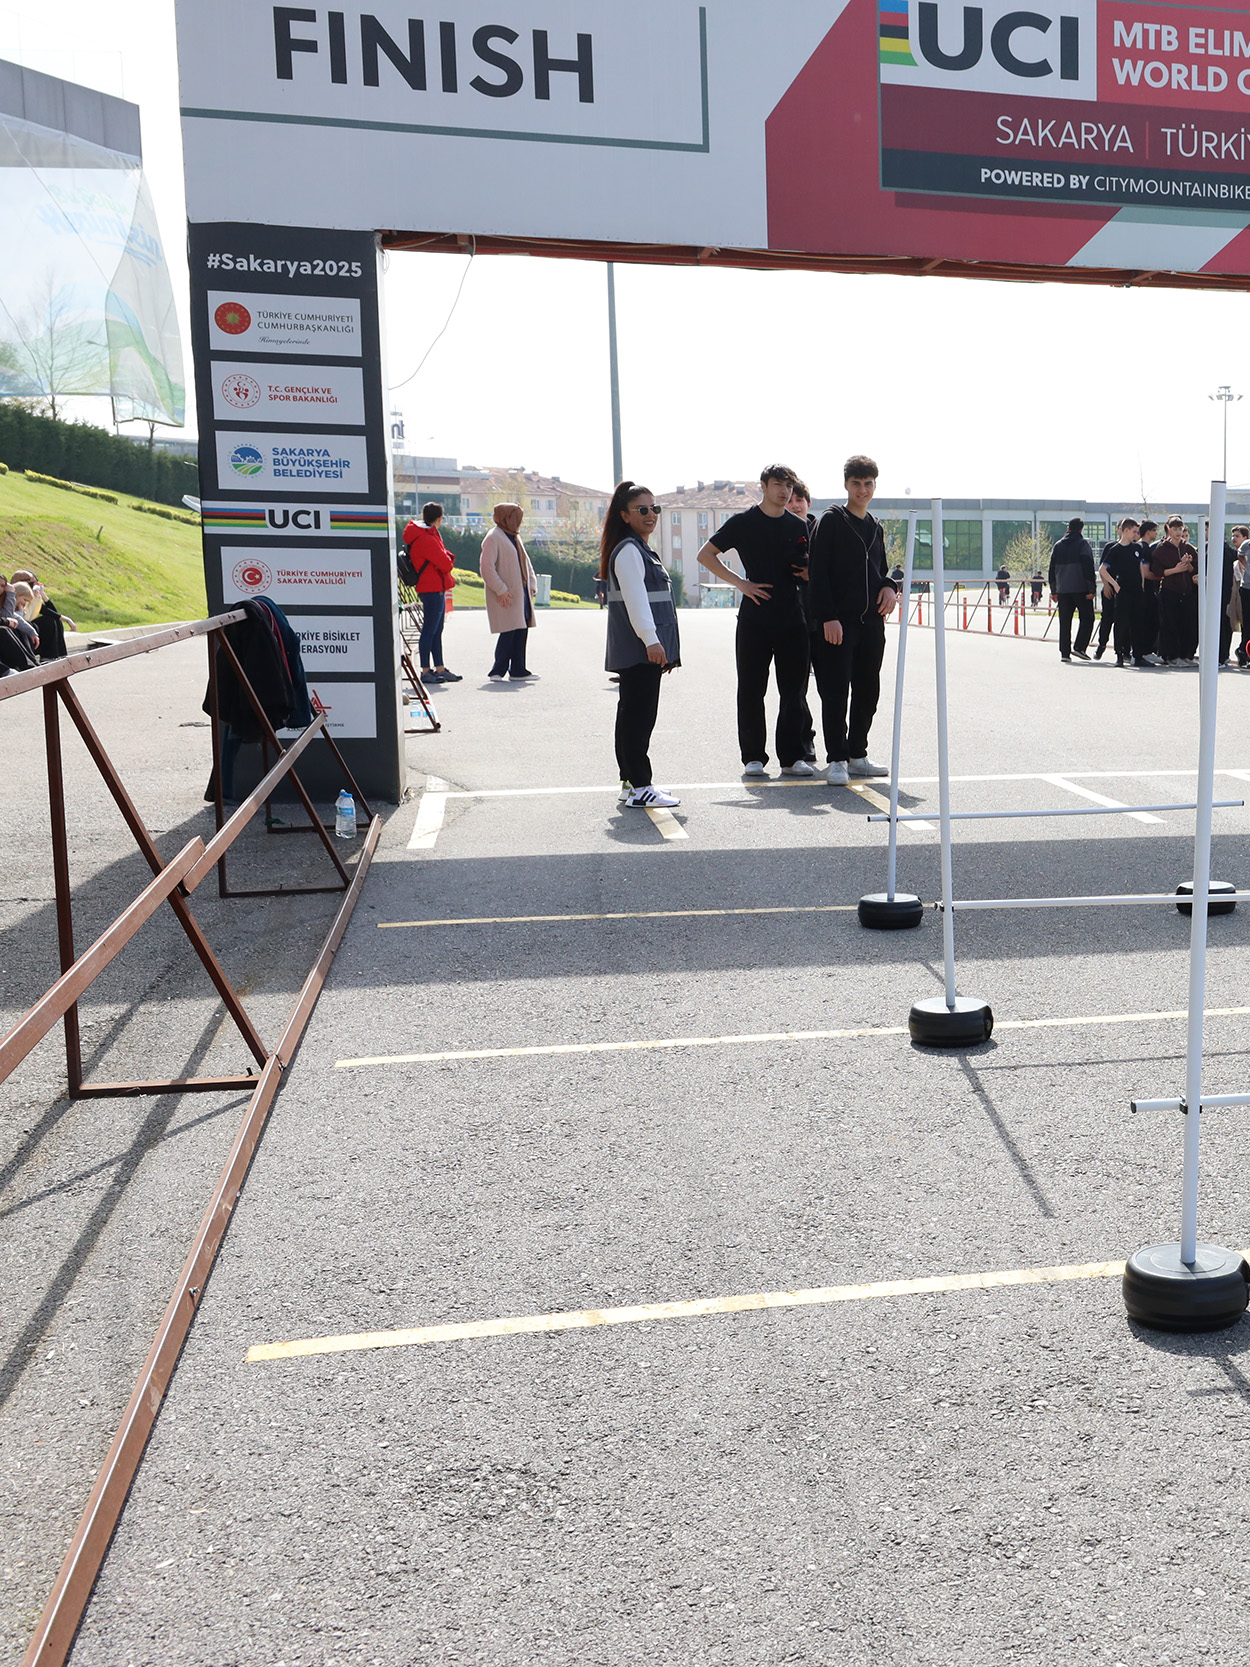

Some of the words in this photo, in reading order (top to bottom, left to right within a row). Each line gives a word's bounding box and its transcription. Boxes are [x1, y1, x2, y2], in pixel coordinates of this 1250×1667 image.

[918, 1, 1079, 81] UCI
[1113, 20, 1179, 52] MTB
[273, 6, 594, 104] FINISH
[1112, 58, 1228, 91] WORLD
[995, 115, 1134, 154] SAKARYA
[980, 168, 1065, 189] POWERED
[1068, 175, 1090, 190] BY
[207, 253, 363, 278] #Sakarya2025
[257, 311, 292, 320] TÜRKİYE
[294, 313, 354, 323] CUMHURİYETİ
[257, 322, 354, 333] CUMHURBAŞKANLIĞI
[268, 385, 283, 393] T.C.
[284, 385, 320, 396] GENÇLİK
[268, 394, 291, 402] SPOR
[292, 394, 338, 403] BAKANLIĞI
[272, 447, 331, 457] SAKARYA
[272, 457, 351, 469] BÜYÜKŞEHİR
[273, 468, 343, 479] BELEDİYESİ
[268, 509, 321, 529] UCI
[276, 569, 308, 577] TÜRKİYE
[310, 570, 363, 578] CUMHURİYETİ
[277, 577, 313, 585] SAKARYA
[295, 630, 320, 641] RKİYE
[323, 630, 360, 641] BİSİKLET
[301, 645, 348, 654] ERASYONU
